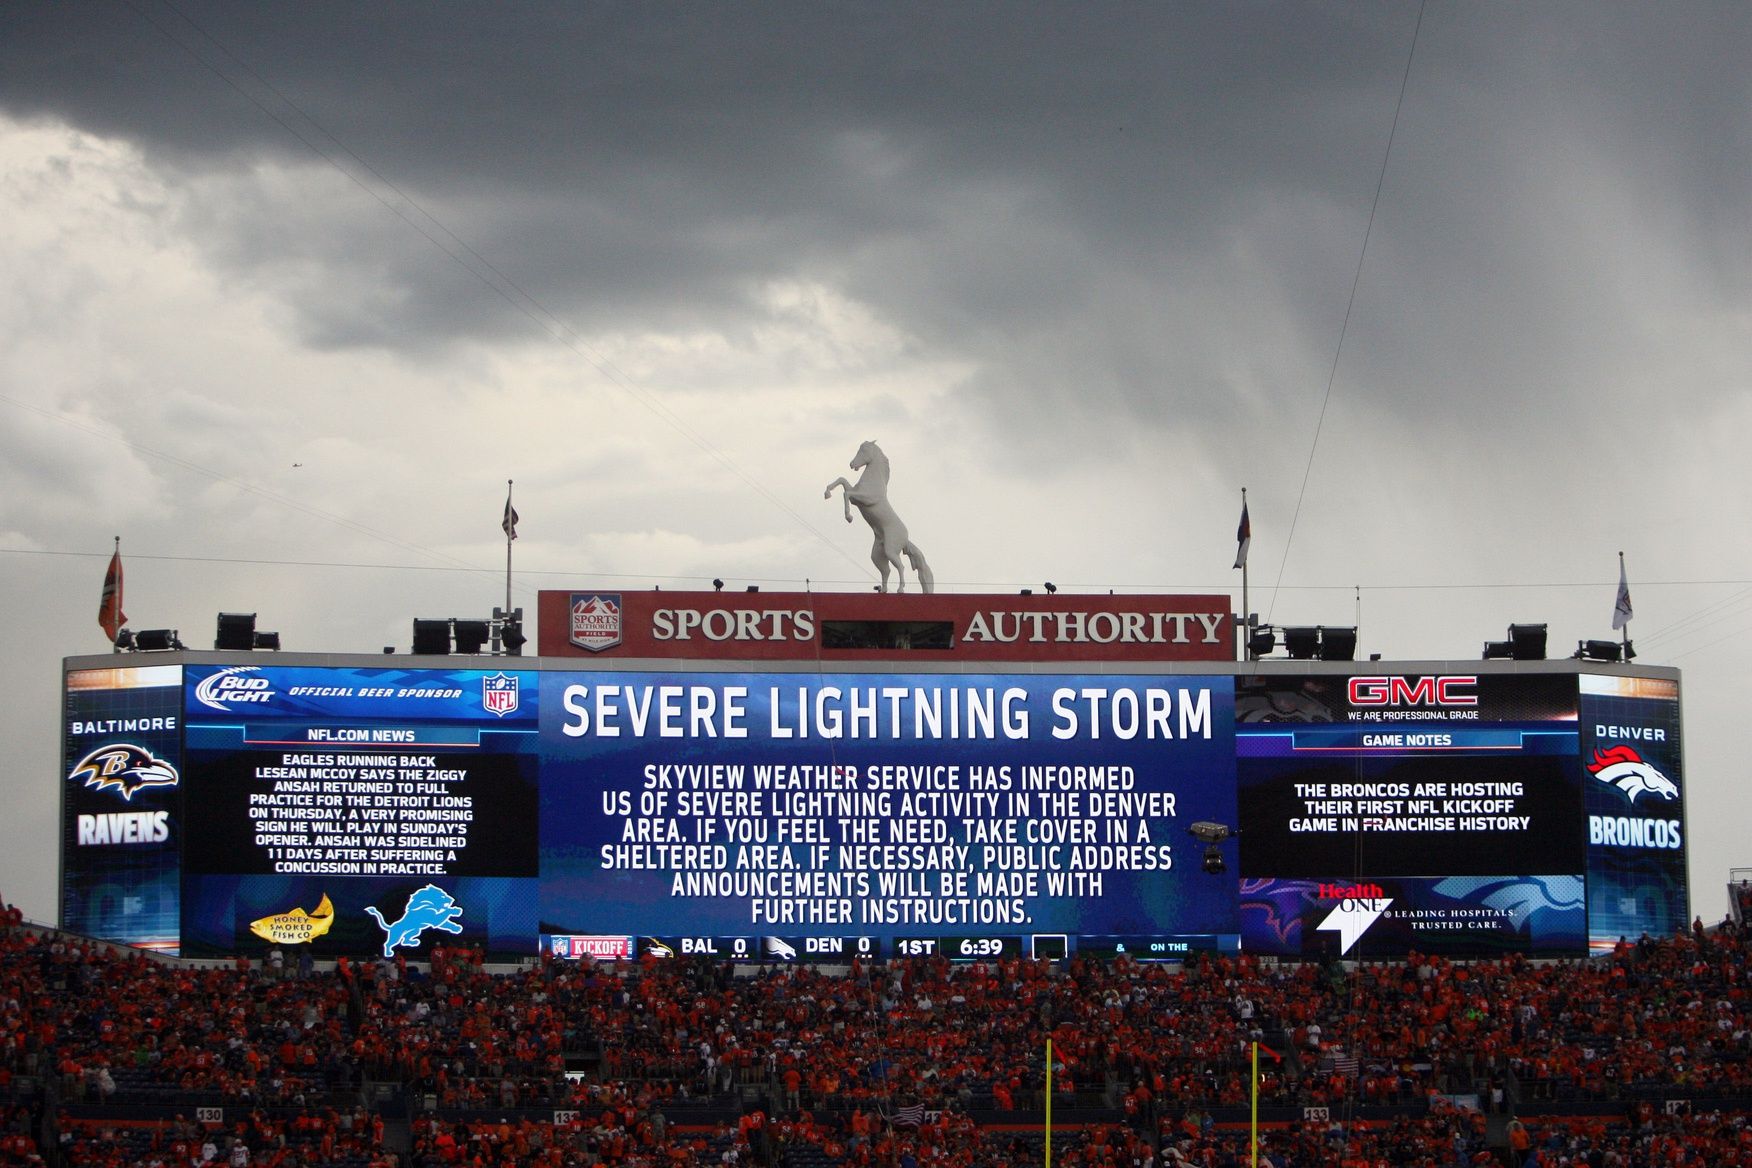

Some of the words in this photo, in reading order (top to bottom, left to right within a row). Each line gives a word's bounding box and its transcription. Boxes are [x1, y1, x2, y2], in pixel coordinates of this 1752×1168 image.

[573, 614, 619, 624] SPORTS
[652, 608, 815, 641] SPORTS
[962, 611, 1225, 643] AUTHORITY
[219, 676, 270, 690] BUD
[207, 688, 276, 702] LIGHT
[288, 686, 353, 697] OFFICIAL
[357, 687, 395, 697] BEER
[397, 688, 463, 698] SPONSOR
[1348, 676, 1479, 706] GMC
[487, 691, 514, 710] NFL
[562, 684, 748, 738] SEVERE
[770, 686, 1029, 740] LIGHTNING
[1051, 687, 1212, 740] STORM
[1347, 711, 1362, 720] WE
[1363, 711, 1382, 720] ARE
[1383, 710, 1448, 720] PROFESSIONAL
[1449, 710, 1479, 720] GRADE
[72, 716, 176, 735] BALTIMORE
[1595, 724, 1665, 742] DENVER
[308, 728, 370, 741] NFL.COM
[372, 730, 416, 743] NEWS
[1362, 734, 1403, 746] GAME
[1406, 734, 1452, 746] NOTES
[283, 754, 335, 766] EAGLES
[337, 755, 397, 767] RUNNING
[400, 755, 436, 767] BACK
[255, 767, 307, 779] LESEAN
[310, 768, 357, 780] MCCOY
[359, 768, 395, 780] SAYS
[397, 769, 424, 781] THE
[426, 769, 467, 781] ZIGGY
[643, 764, 745, 790] SKYVIEW
[753, 765, 858, 790] WEATHER
[867, 765, 960, 791] SERVICE
[969, 765, 1012, 791] HAS
[1021, 765, 1135, 791] INFORMED
[274, 780, 320, 793] ANSAH
[323, 781, 393, 794] RETURNED
[395, 782, 414, 794] TO
[416, 782, 449, 794] FULL
[1294, 783, 1327, 798] THE
[1330, 783, 1410, 797] BRONCOS
[1413, 782, 1447, 797] ARE
[1450, 782, 1524, 797] HOSTING
[250, 793, 314, 806] PRACTICE
[316, 794, 343, 806] FOR
[345, 795, 372, 807] THE
[374, 795, 431, 807] DETROIT
[433, 796, 473, 808] LIONS
[603, 790, 632, 816] US
[640, 790, 668, 816] OF
[677, 791, 763, 816] SEVERE
[772, 791, 892, 817] LIGHTNING
[900, 792, 1000, 817] ACTIVITY
[1008, 792, 1030, 817] IN
[1038, 792, 1080, 817] THE
[1089, 792, 1176, 817] DENVER
[1304, 800, 1353, 815] THEIR
[1357, 800, 1404, 814] FIRST
[1408, 800, 1440, 814] NFL
[1443, 799, 1515, 814] KICKOFF
[249, 807, 268, 819] ON
[271, 807, 346, 821] THURSDAY,
[348, 808, 359, 820] A
[361, 808, 397, 820] VERY
[399, 808, 473, 821] PROMISING
[77, 810, 170, 846] RAVENS
[255, 820, 287, 832] SIGN
[290, 821, 308, 833] HE
[311, 821, 344, 833] WILL
[346, 822, 381, 834] PLAY
[383, 822, 398, 834] IN
[400, 822, 467, 835] SUNDAY'S
[1289, 817, 1338, 832] GAME
[1341, 817, 1359, 832] IN
[1362, 817, 1456, 832] FRANCHISE
[1459, 816, 1531, 831] HISTORY
[621, 817, 687, 843] AREA.
[697, 818, 716, 843] IF
[724, 818, 768, 843] YOU
[777, 818, 831, 843] FEEL
[838, 818, 881, 843] THE
[889, 818, 955, 847] NEED,
[962, 818, 1018, 844] TAKE
[1026, 818, 1097, 844] COVER
[1106, 819, 1128, 844] IN
[1136, 819, 1151, 844] A
[1588, 815, 1681, 849] BRONCOS
[255, 834, 312, 846] OPENER.
[314, 835, 361, 847] ANSAH
[363, 835, 396, 847] WAS
[398, 836, 467, 848] SIDELINED
[267, 848, 283, 859] 11
[285, 848, 323, 860] DAYS
[325, 849, 368, 861] AFTER
[370, 849, 444, 862] SUFFERING
[446, 850, 457, 862] A
[601, 844, 729, 870] SHELTERED
[736, 845, 801, 870] AREA.
[810, 845, 830, 870] IF
[839, 845, 974, 874] NECESSARY,
[983, 845, 1061, 870] PUBLIC
[1069, 845, 1172, 870] ADDRESS
[275, 861, 360, 874] CONCUSSION
[363, 862, 377, 874] IN
[380, 862, 447, 875] PRACTICE.
[671, 871, 870, 897] ANNOUNCEMENTS
[878, 872, 932, 897] WILL
[940, 872, 969, 897] BE
[977, 872, 1038, 897] MADE
[1046, 872, 1103, 897] WITH
[1318, 883, 1384, 899] Health
[752, 898, 853, 924] FURTHER
[862, 898, 1032, 924] INSTRUCTIONS.
[1339, 898, 1383, 913] ONE
[274, 916, 309, 924] HONEY
[1394, 910, 1446, 918] LEADING
[1450, 909, 1518, 918] HOSPITALS.
[1411, 921, 1463, 930] TRUSTED
[1467, 921, 1502, 929] CARE.
[272, 931, 295, 939] FISH
[574, 940, 624, 955] KICKOFF
[681, 938, 718, 953] BAL
[734, 938, 747, 953] 0
[805, 937, 842, 953] DEN
[858, 937, 870, 952] 0
[898, 940, 936, 955] 1ST
[960, 939, 1003, 955] 6:39
[1150, 943, 1165, 951] ON
[1167, 943, 1188, 951] THE
[199, 1109, 222, 1121] 130
[1305, 1109, 1328, 1121] 133
